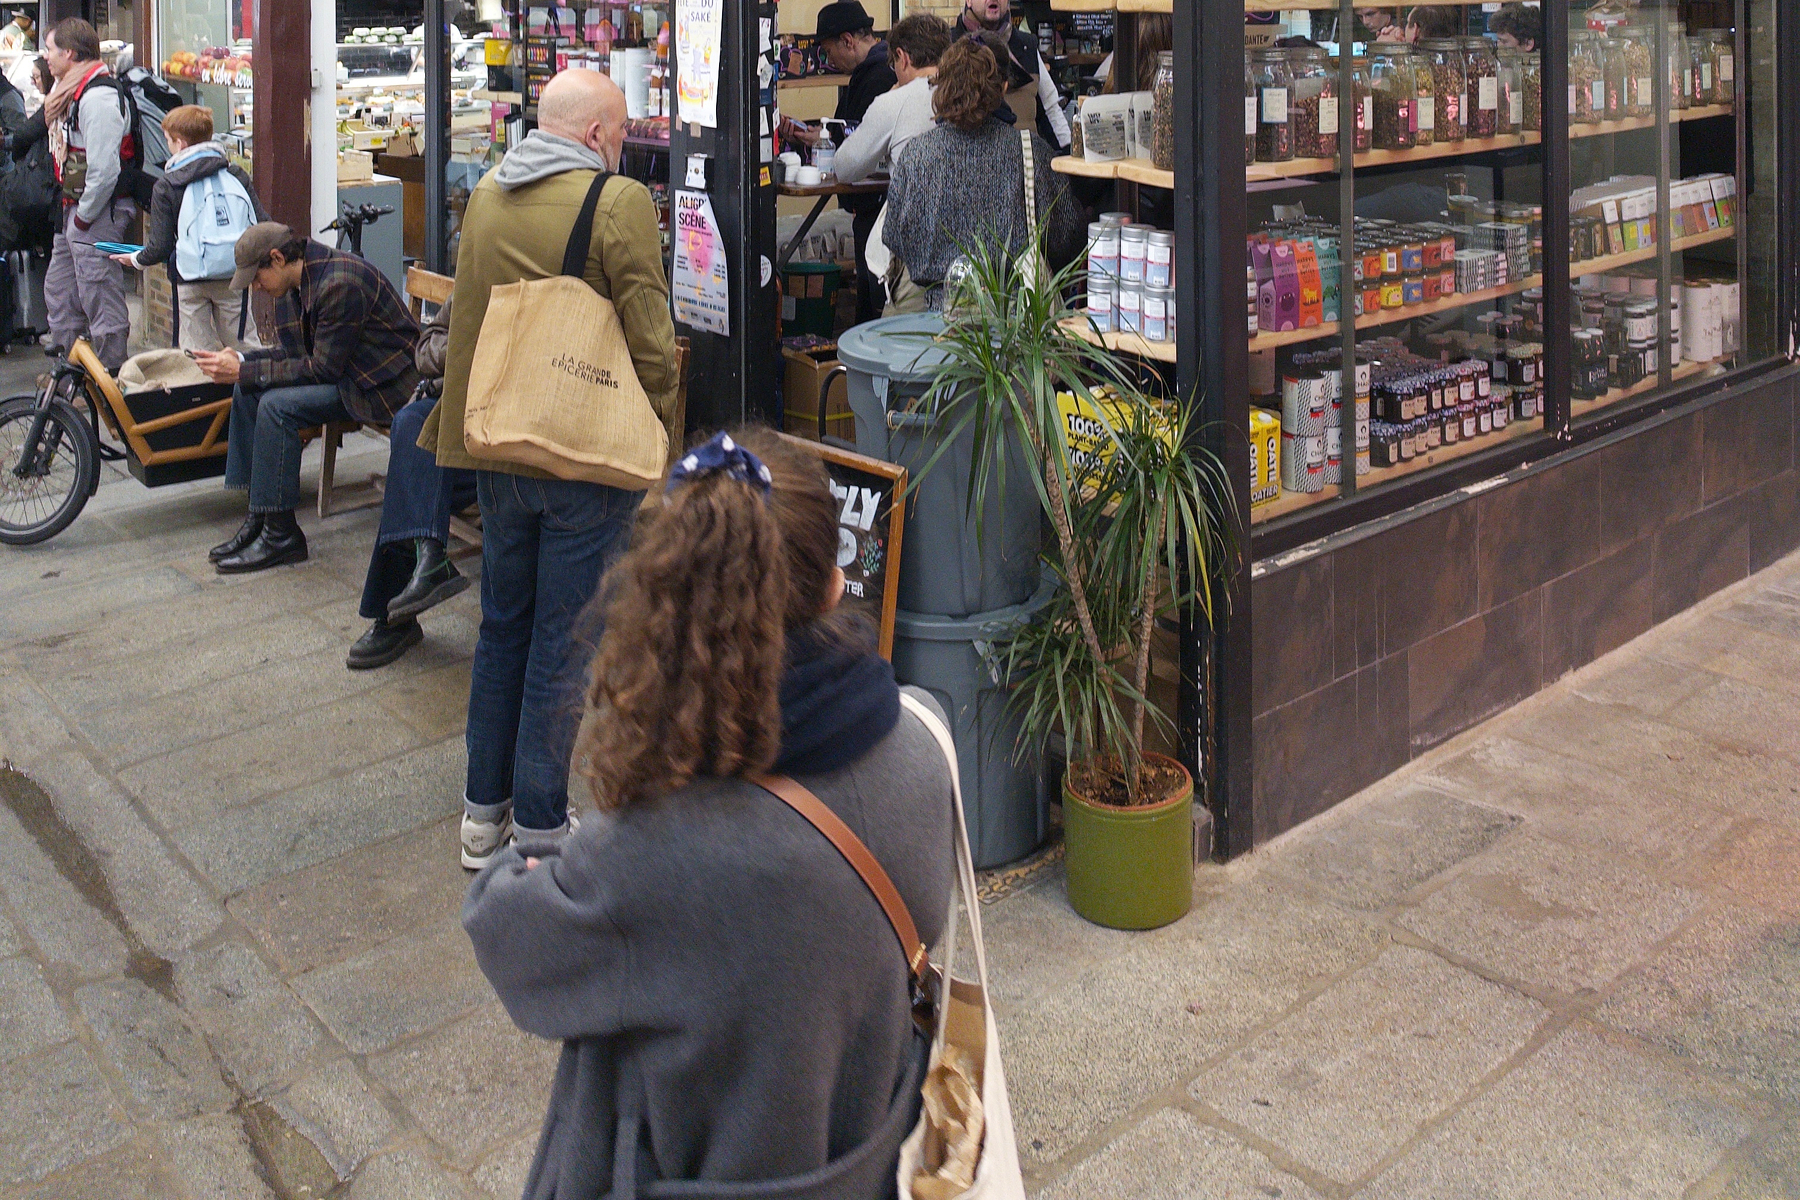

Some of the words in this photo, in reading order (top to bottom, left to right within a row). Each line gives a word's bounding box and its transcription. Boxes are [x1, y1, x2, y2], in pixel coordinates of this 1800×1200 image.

[690, 10, 711, 22] SAKÉ
[679, 211, 706, 230] SCÈNE
[562, 352, 574, 365] LA
[578, 360, 611, 379] GRANDE
[596, 377, 618, 389] PARIS
[1251, 484, 1278, 503] OATIER
